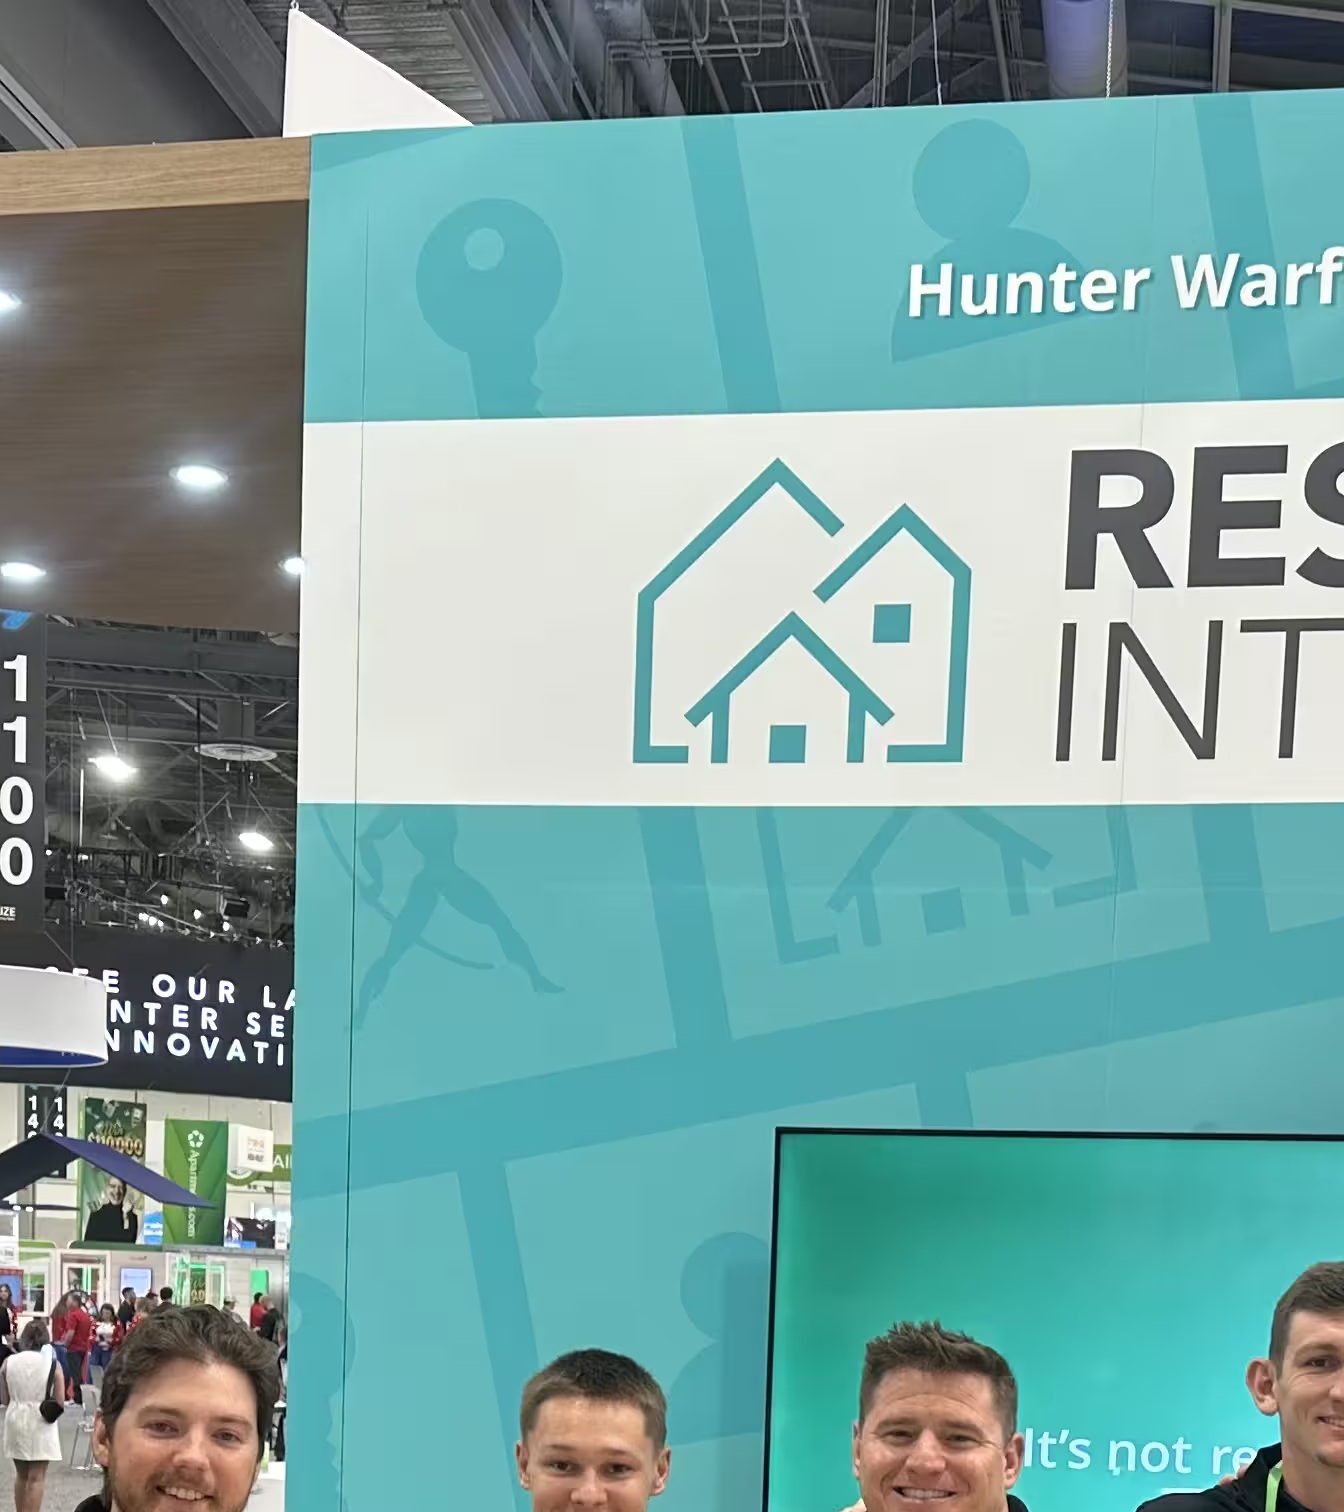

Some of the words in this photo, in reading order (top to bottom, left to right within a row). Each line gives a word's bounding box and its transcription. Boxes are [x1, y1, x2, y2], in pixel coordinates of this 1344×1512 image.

[907, 260, 1150, 318] Hunter
[152, 974, 235, 1004] OUR
[1109, 1434, 1192, 1475] not
